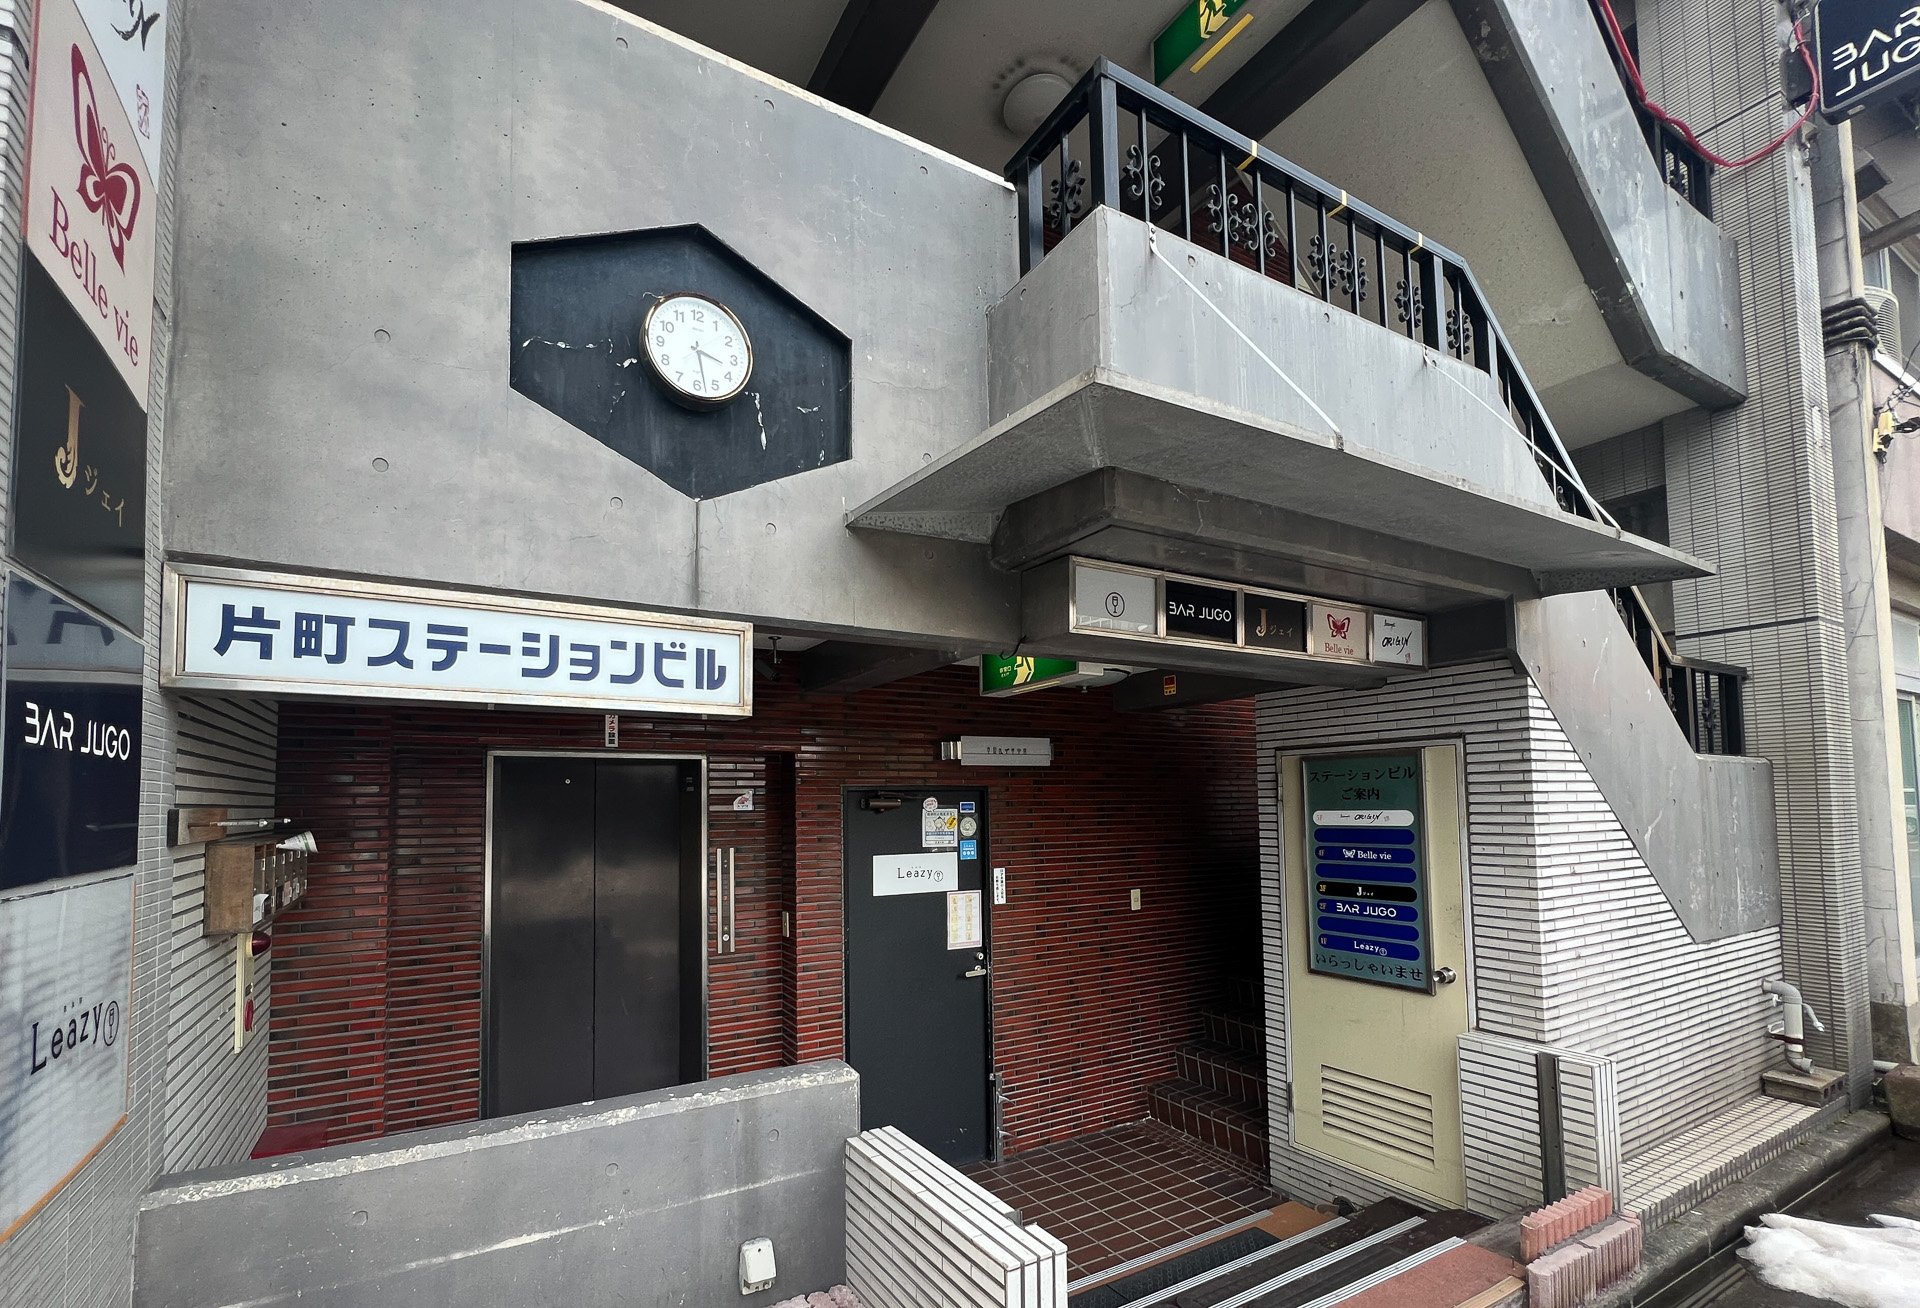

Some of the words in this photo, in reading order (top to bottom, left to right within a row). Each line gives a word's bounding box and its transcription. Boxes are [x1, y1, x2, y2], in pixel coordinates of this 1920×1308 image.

[49, 185, 108, 319] Belle
[113, 305, 138, 367] vie
[673, 309, 685, 323] 11
[690, 309, 704, 323] 12
[659, 320, 675, 333] 10
[712, 320, 718, 332] 1
[655, 335, 665, 347] 9
[724, 335, 733, 347] 2
[660, 353, 670, 366] 8
[729, 354, 738, 366] 3
[674, 370, 684, 382] 7
[723, 371, 733, 382] 4
[692, 379, 702, 391] 6
[710, 379, 720, 391] 5
[55, 383, 86, 489] J
[84, 464, 125, 528] ジェイ
[1169, 601, 1195, 618] BAR
[1198, 607, 1232, 622] JUGO
[1256, 608, 1268, 637] J
[1270, 624, 1293, 638] ジェイ
[213, 603, 727, 691] 片町ステーションビル
[1325, 643, 1342, 653] Belle
[1343, 646, 1354, 655] vie
[25, 701, 73, 752] BAR
[80, 719, 130, 761] JUGO
[1309, 766, 1416, 783] ステーションビル
[1341, 787, 1380, 801] ご案内
[1357, 850, 1377, 859] Belle
[1379, 852, 1392, 860] vie
[897, 867, 933, 880] Leazy
[1356, 886, 1363, 896] J
[1336, 902, 1360, 914] BAR
[1363, 906, 1397, 917] JUGO
[1353, 941, 1379, 953] Leazy
[1315, 952, 1424, 981] いらっしゃいませ
[30, 1002, 104, 1076] Leazy
